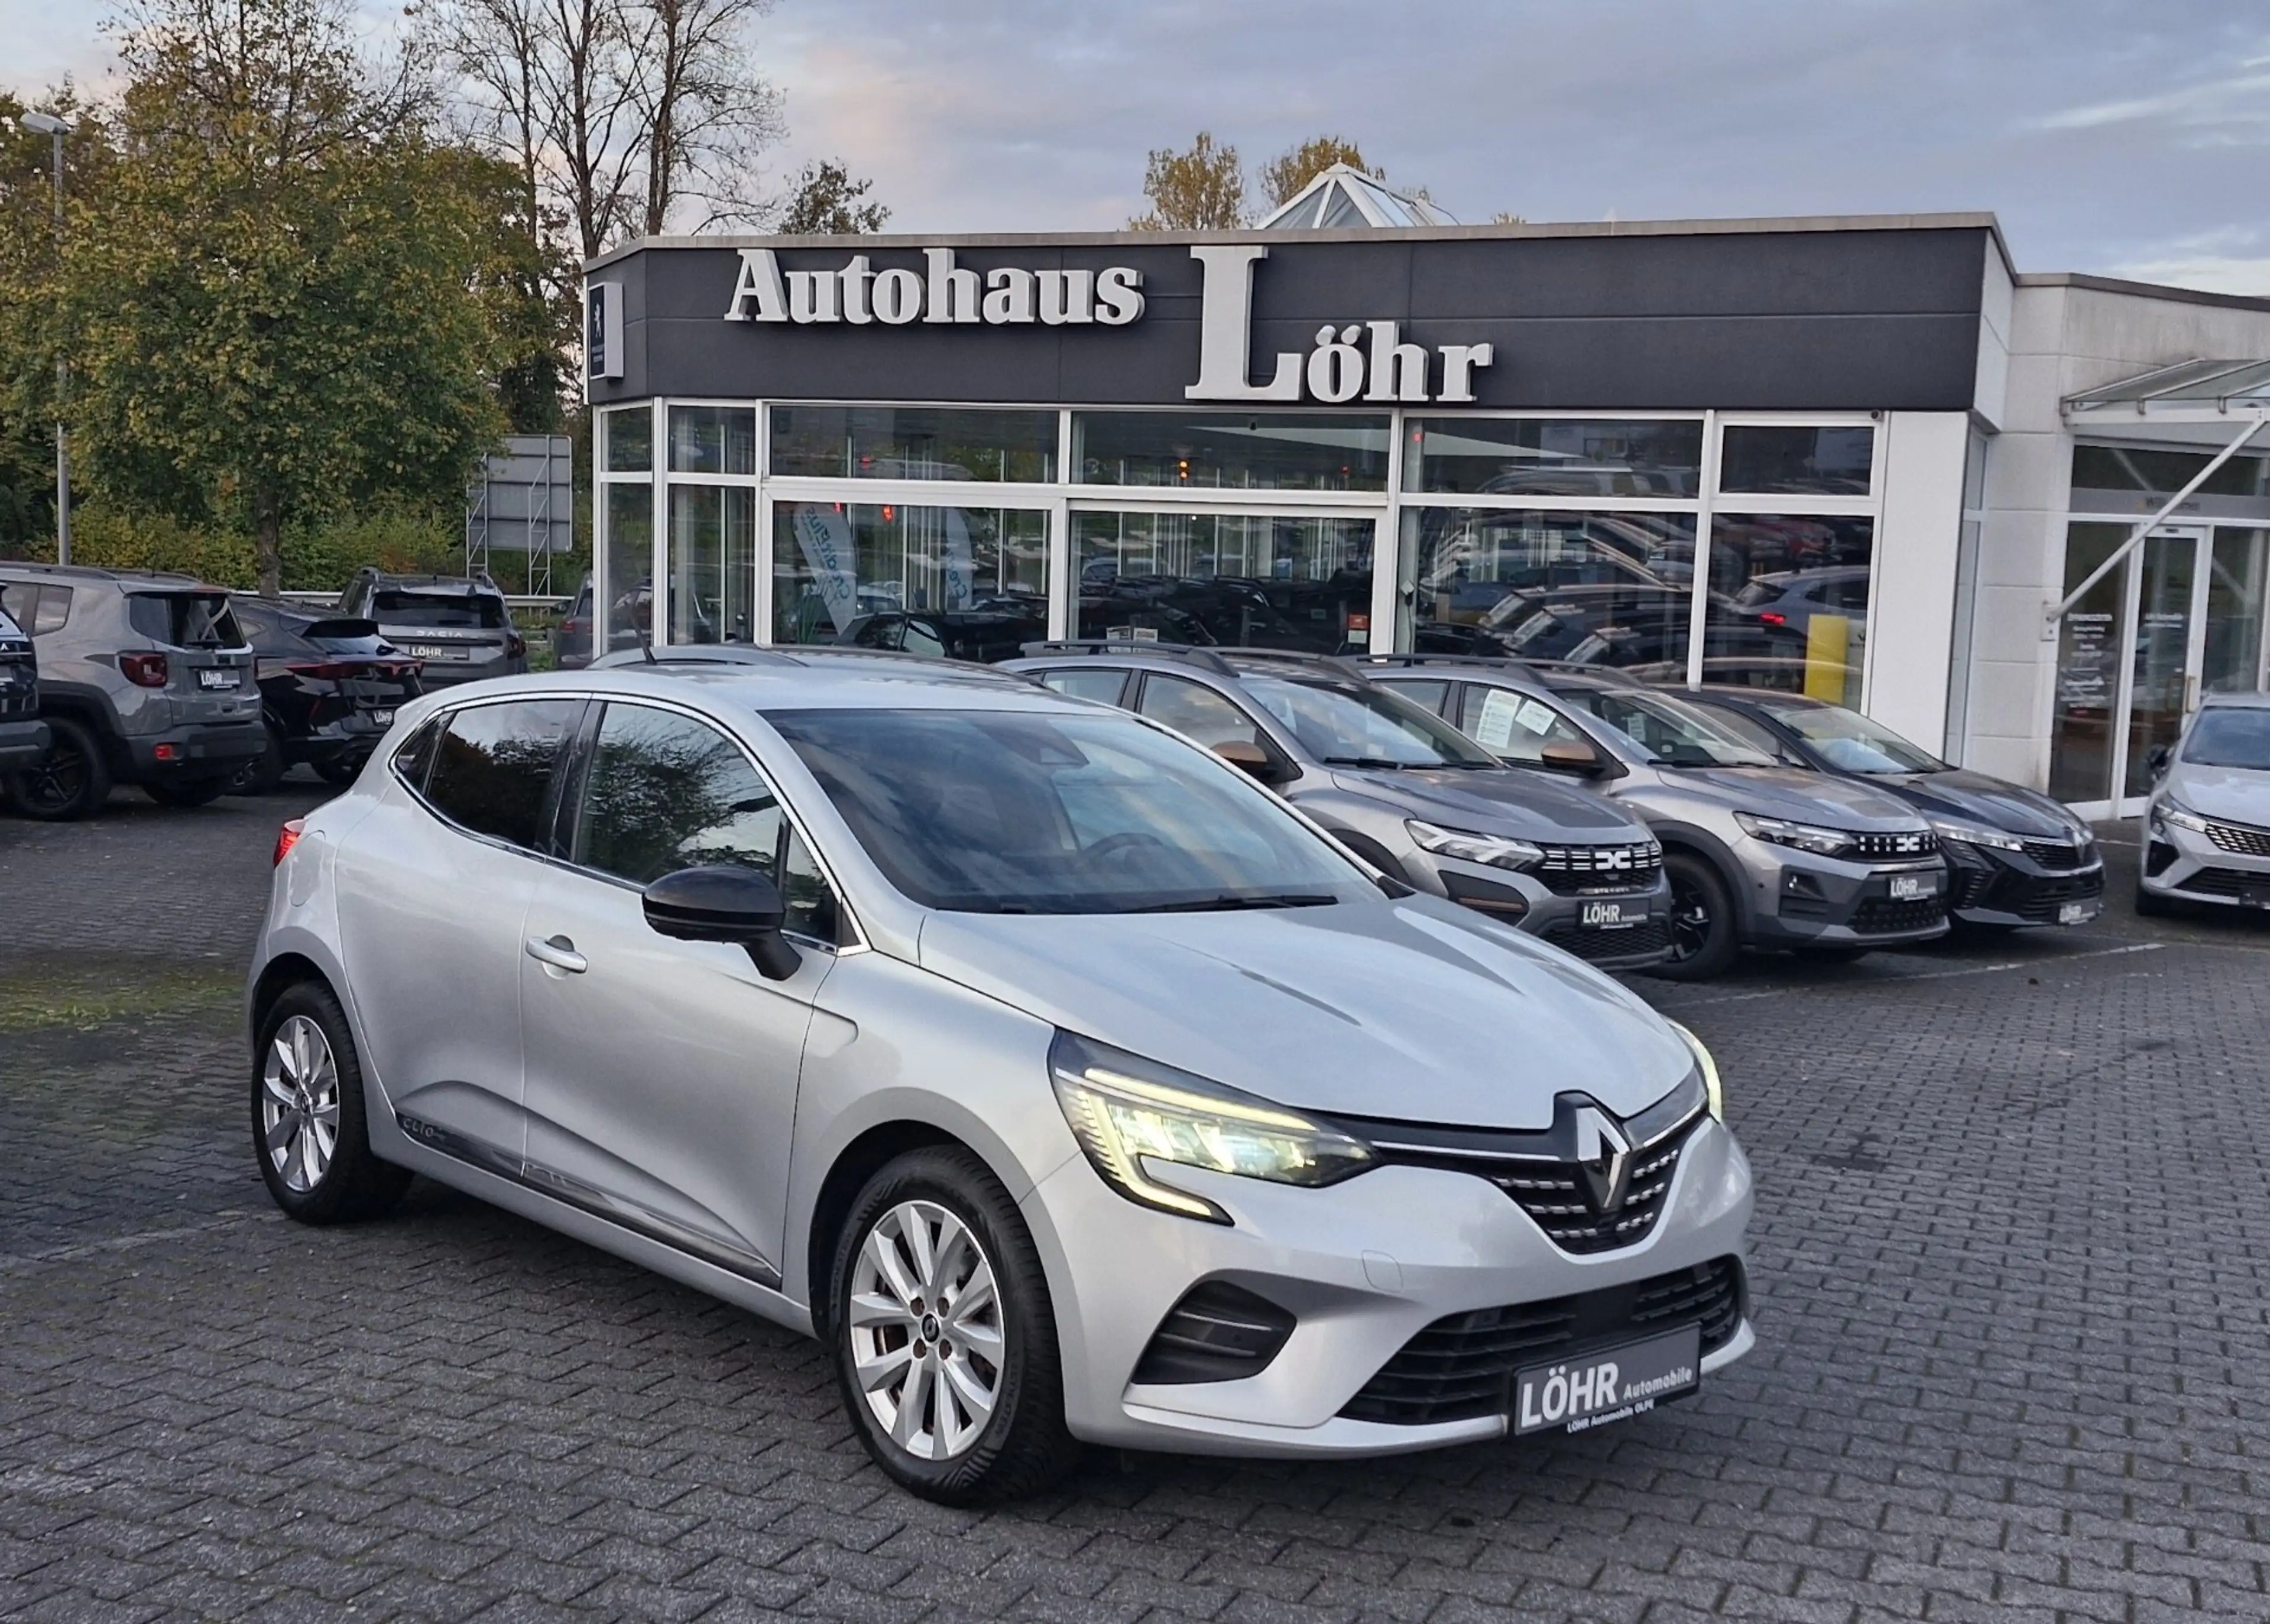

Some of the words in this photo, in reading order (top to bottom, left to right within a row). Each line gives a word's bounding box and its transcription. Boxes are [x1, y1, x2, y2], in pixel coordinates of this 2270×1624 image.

[724, 248, 1146, 325] Autohaus
[1184, 245, 1494, 403] Löhr
[412, 645, 442, 657] LÖHR
[1890, 877, 1918, 897] LÖHR
[1583, 901, 1620, 924] LÖHR
[1521, 1362, 1619, 1428] LÖHR
[1623, 1366, 1692, 1401] Automobile
[1567, 1418, 1590, 1434] LÖHR
